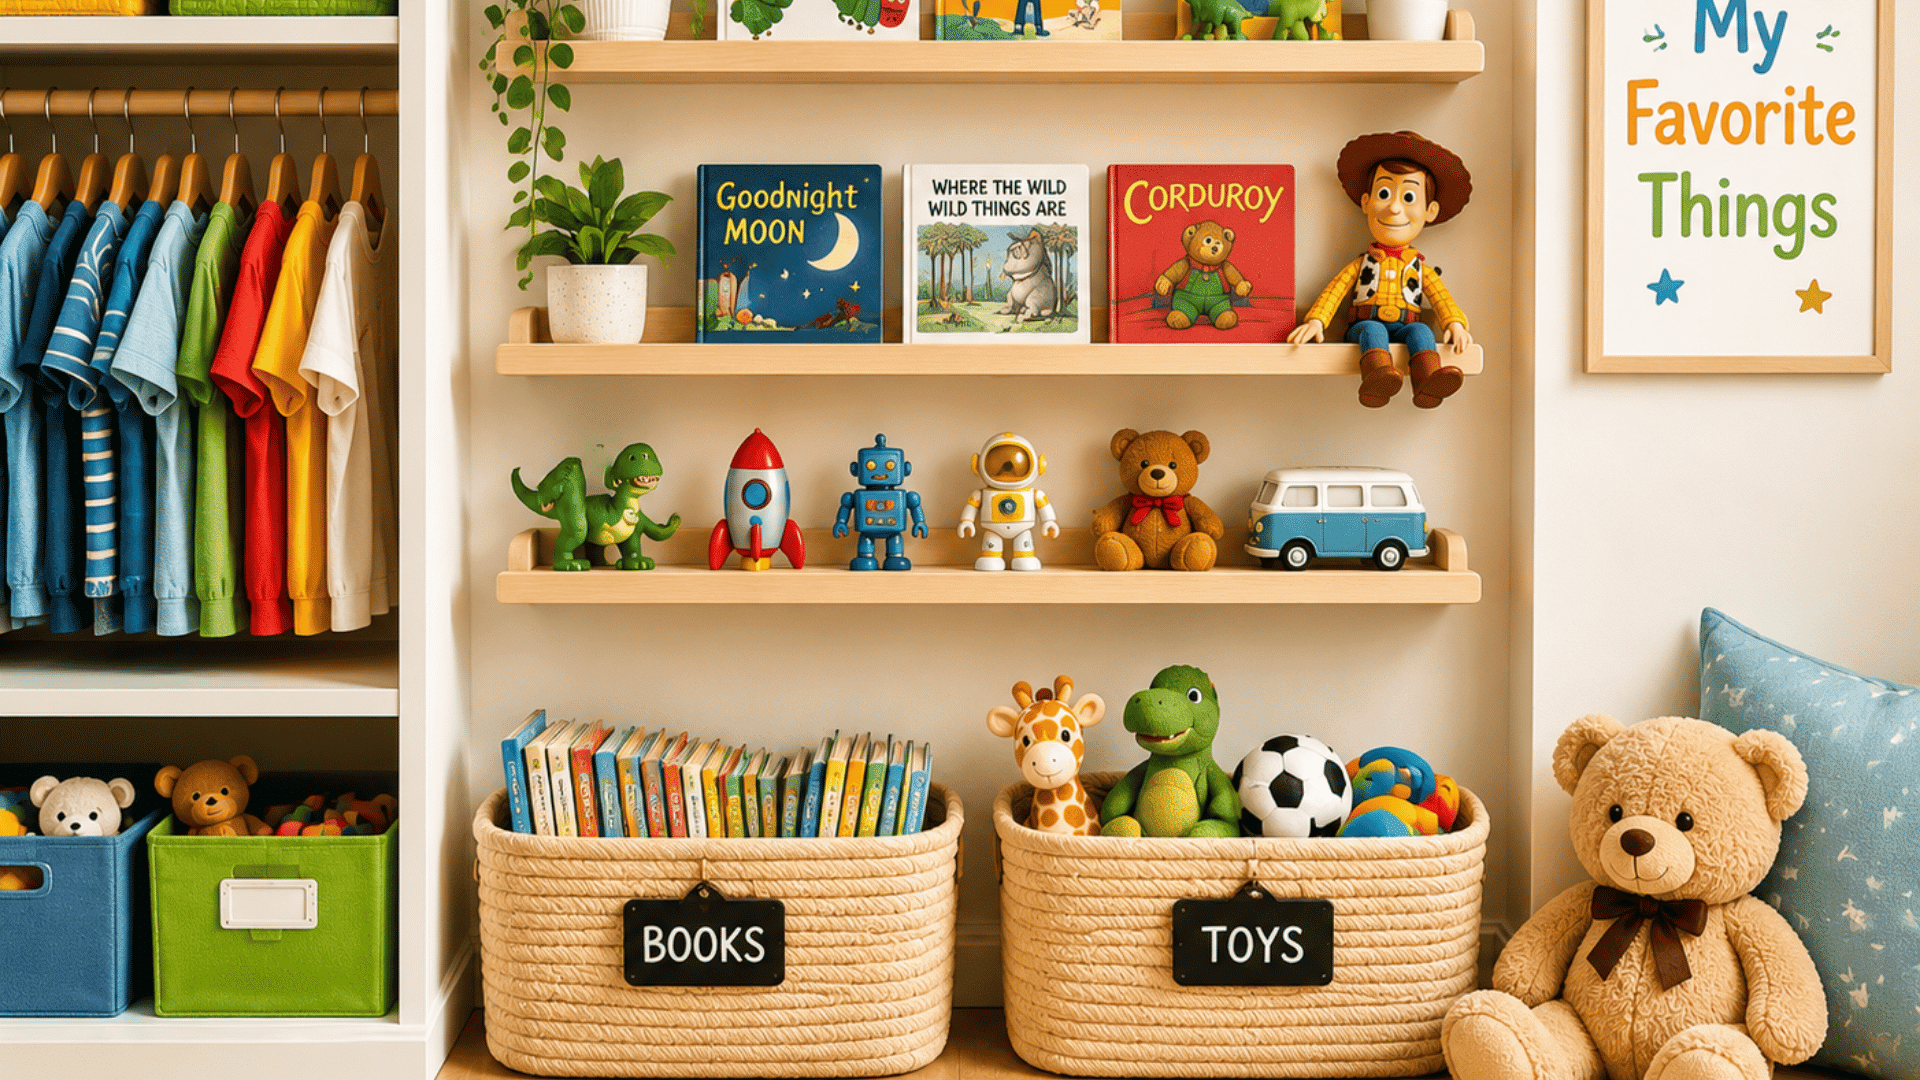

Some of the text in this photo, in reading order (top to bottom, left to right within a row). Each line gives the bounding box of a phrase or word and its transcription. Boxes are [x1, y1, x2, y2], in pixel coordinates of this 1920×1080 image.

[1694, 0, 1788, 75] My
[1626, 78, 1857, 146] Favorite
[932, 179, 1067, 196] WHERE THE WILD
[1123, 179, 1285, 225] CORDUROY
[928, 200, 1067, 217] WILD THINGS ARE
[1637, 170, 1838, 260] Things
[724, 217, 805, 245] MOON
[643, 925, 765, 963] BOOKS
[1201, 925, 1304, 964] TOYS
